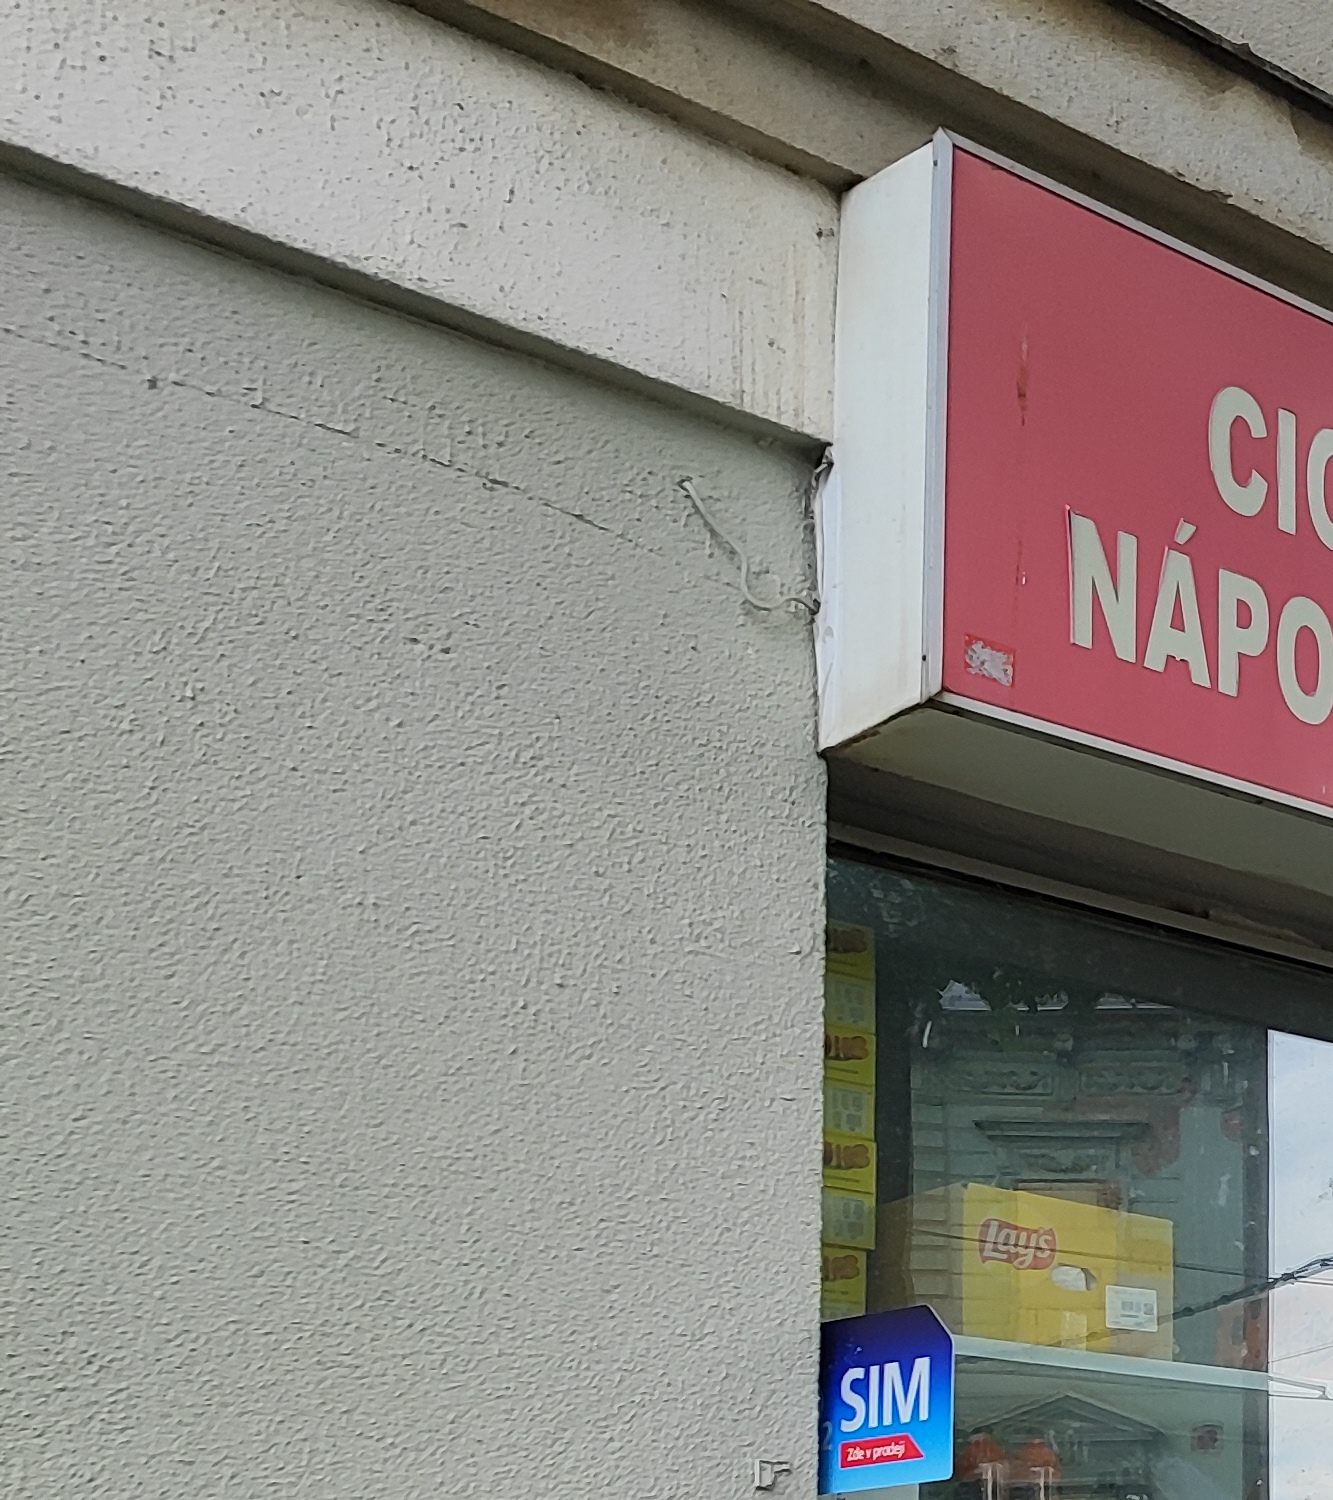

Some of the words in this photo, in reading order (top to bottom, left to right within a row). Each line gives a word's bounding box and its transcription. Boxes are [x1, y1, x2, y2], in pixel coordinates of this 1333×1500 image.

[981, 1219, 1054, 1267] Lay's
[840, 1357, 930, 1432] SIM
[846, 1446, 865, 1462] Zde
[866, 1448, 872, 1458] v
